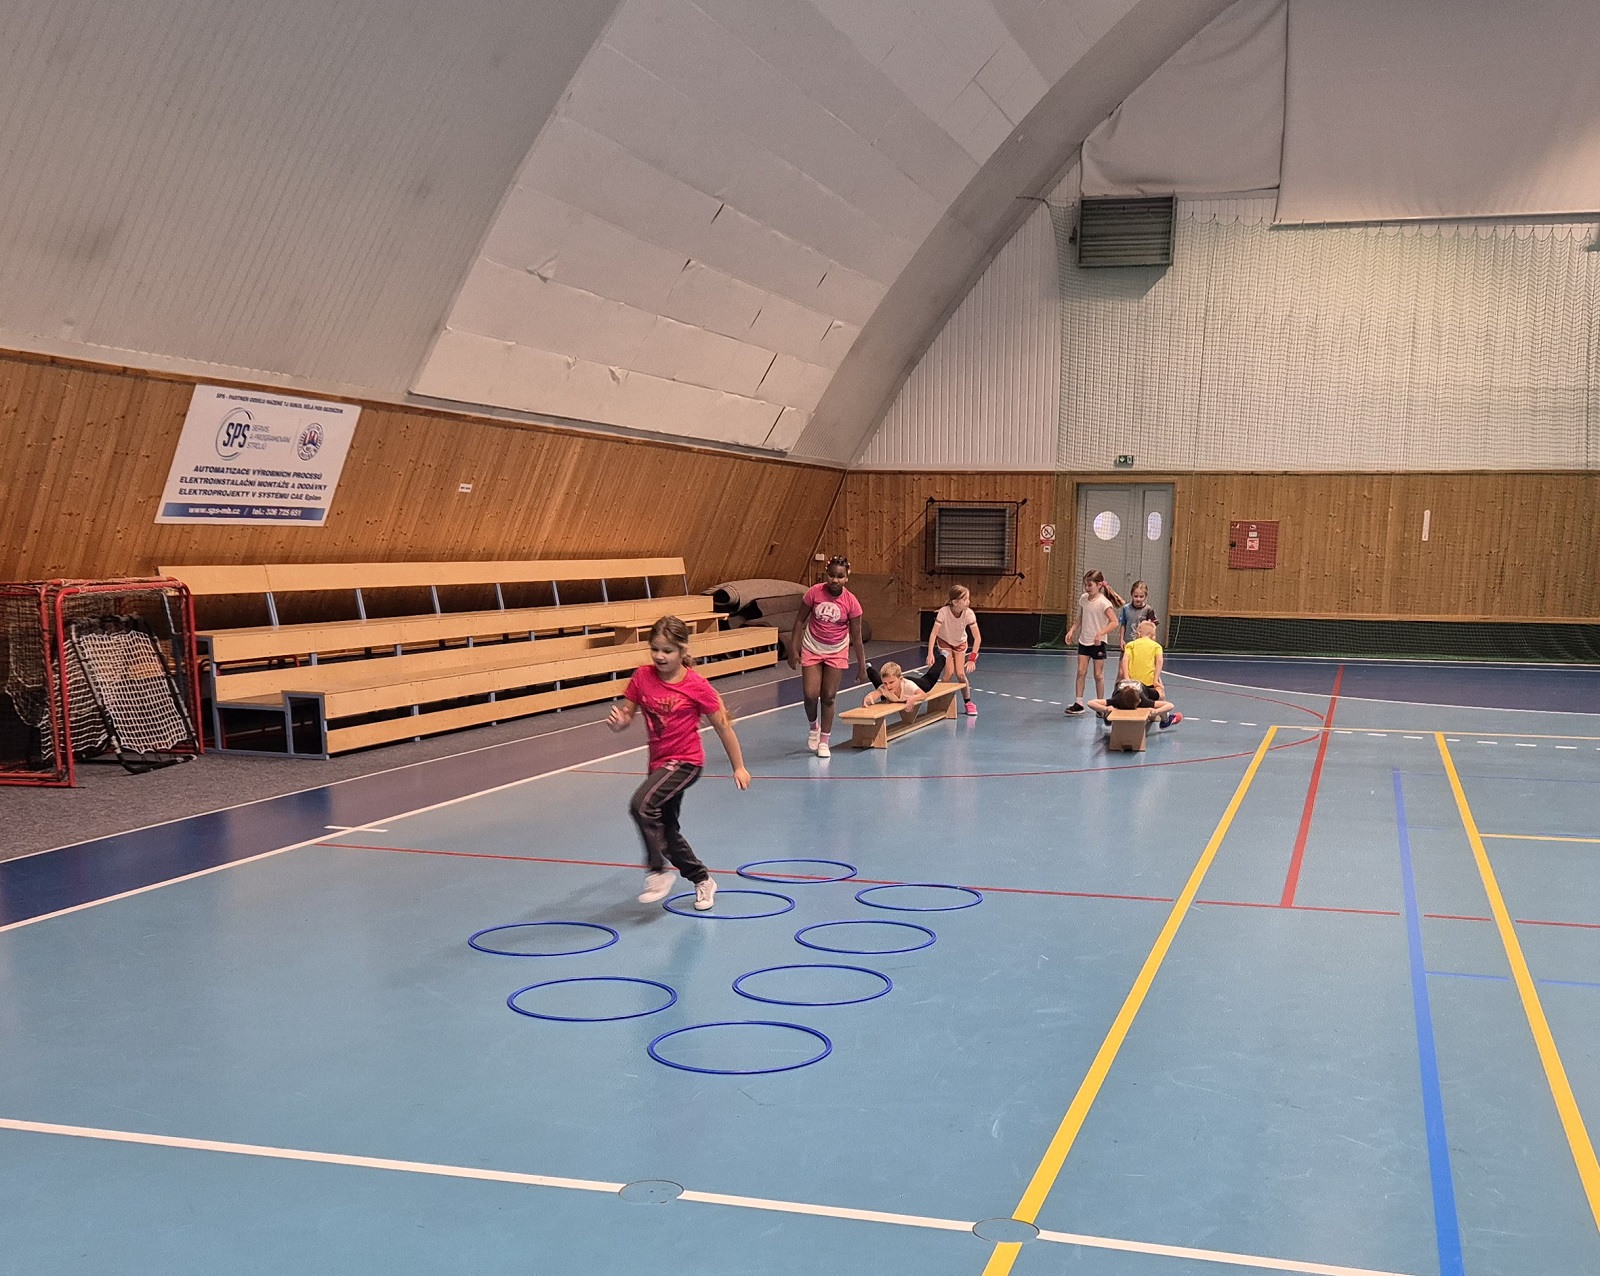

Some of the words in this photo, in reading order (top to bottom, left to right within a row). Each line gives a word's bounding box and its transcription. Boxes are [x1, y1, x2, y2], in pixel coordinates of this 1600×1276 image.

[222, 422, 250, 448] SPS
[193, 465, 251, 476] AUTOMATIZACE
[252, 468, 292, 478] VÝROBNÍCH
[179, 476, 257, 486] ELEKTROINSTALAČNÍ
[257, 480, 290, 488] MONTÁŽE
[296, 482, 328, 490] DODÁVKY
[178, 488, 250, 498] ELEKTROPROJEKTY
[258, 491, 290, 499] SYSTÉMU
